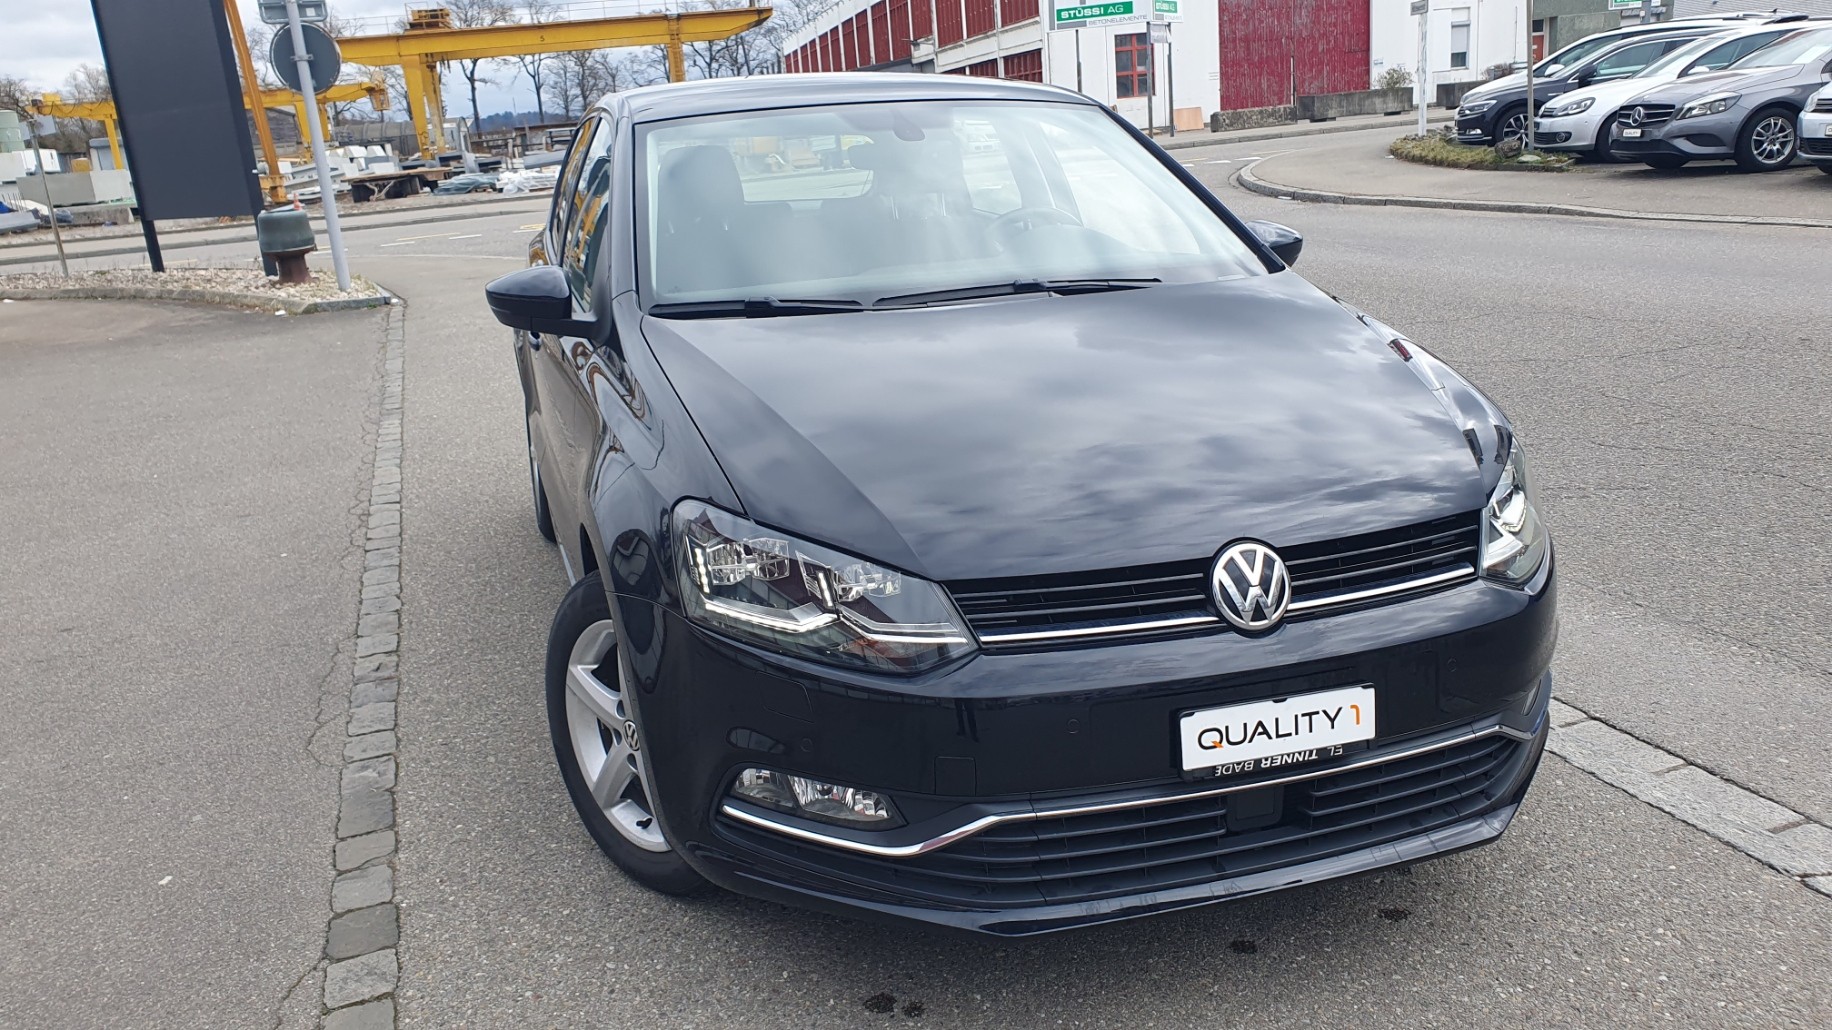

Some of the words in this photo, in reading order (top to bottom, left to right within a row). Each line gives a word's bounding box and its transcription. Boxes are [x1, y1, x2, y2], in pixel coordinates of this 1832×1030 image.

[1061, 7, 1104, 19] STÜSSI
[1107, 5, 1124, 14] AG
[1088, 14, 1148, 26] BETONELEMENTE
[1213, 543, 1290, 630] VW
[1261, 749, 1319, 768] TINNER
